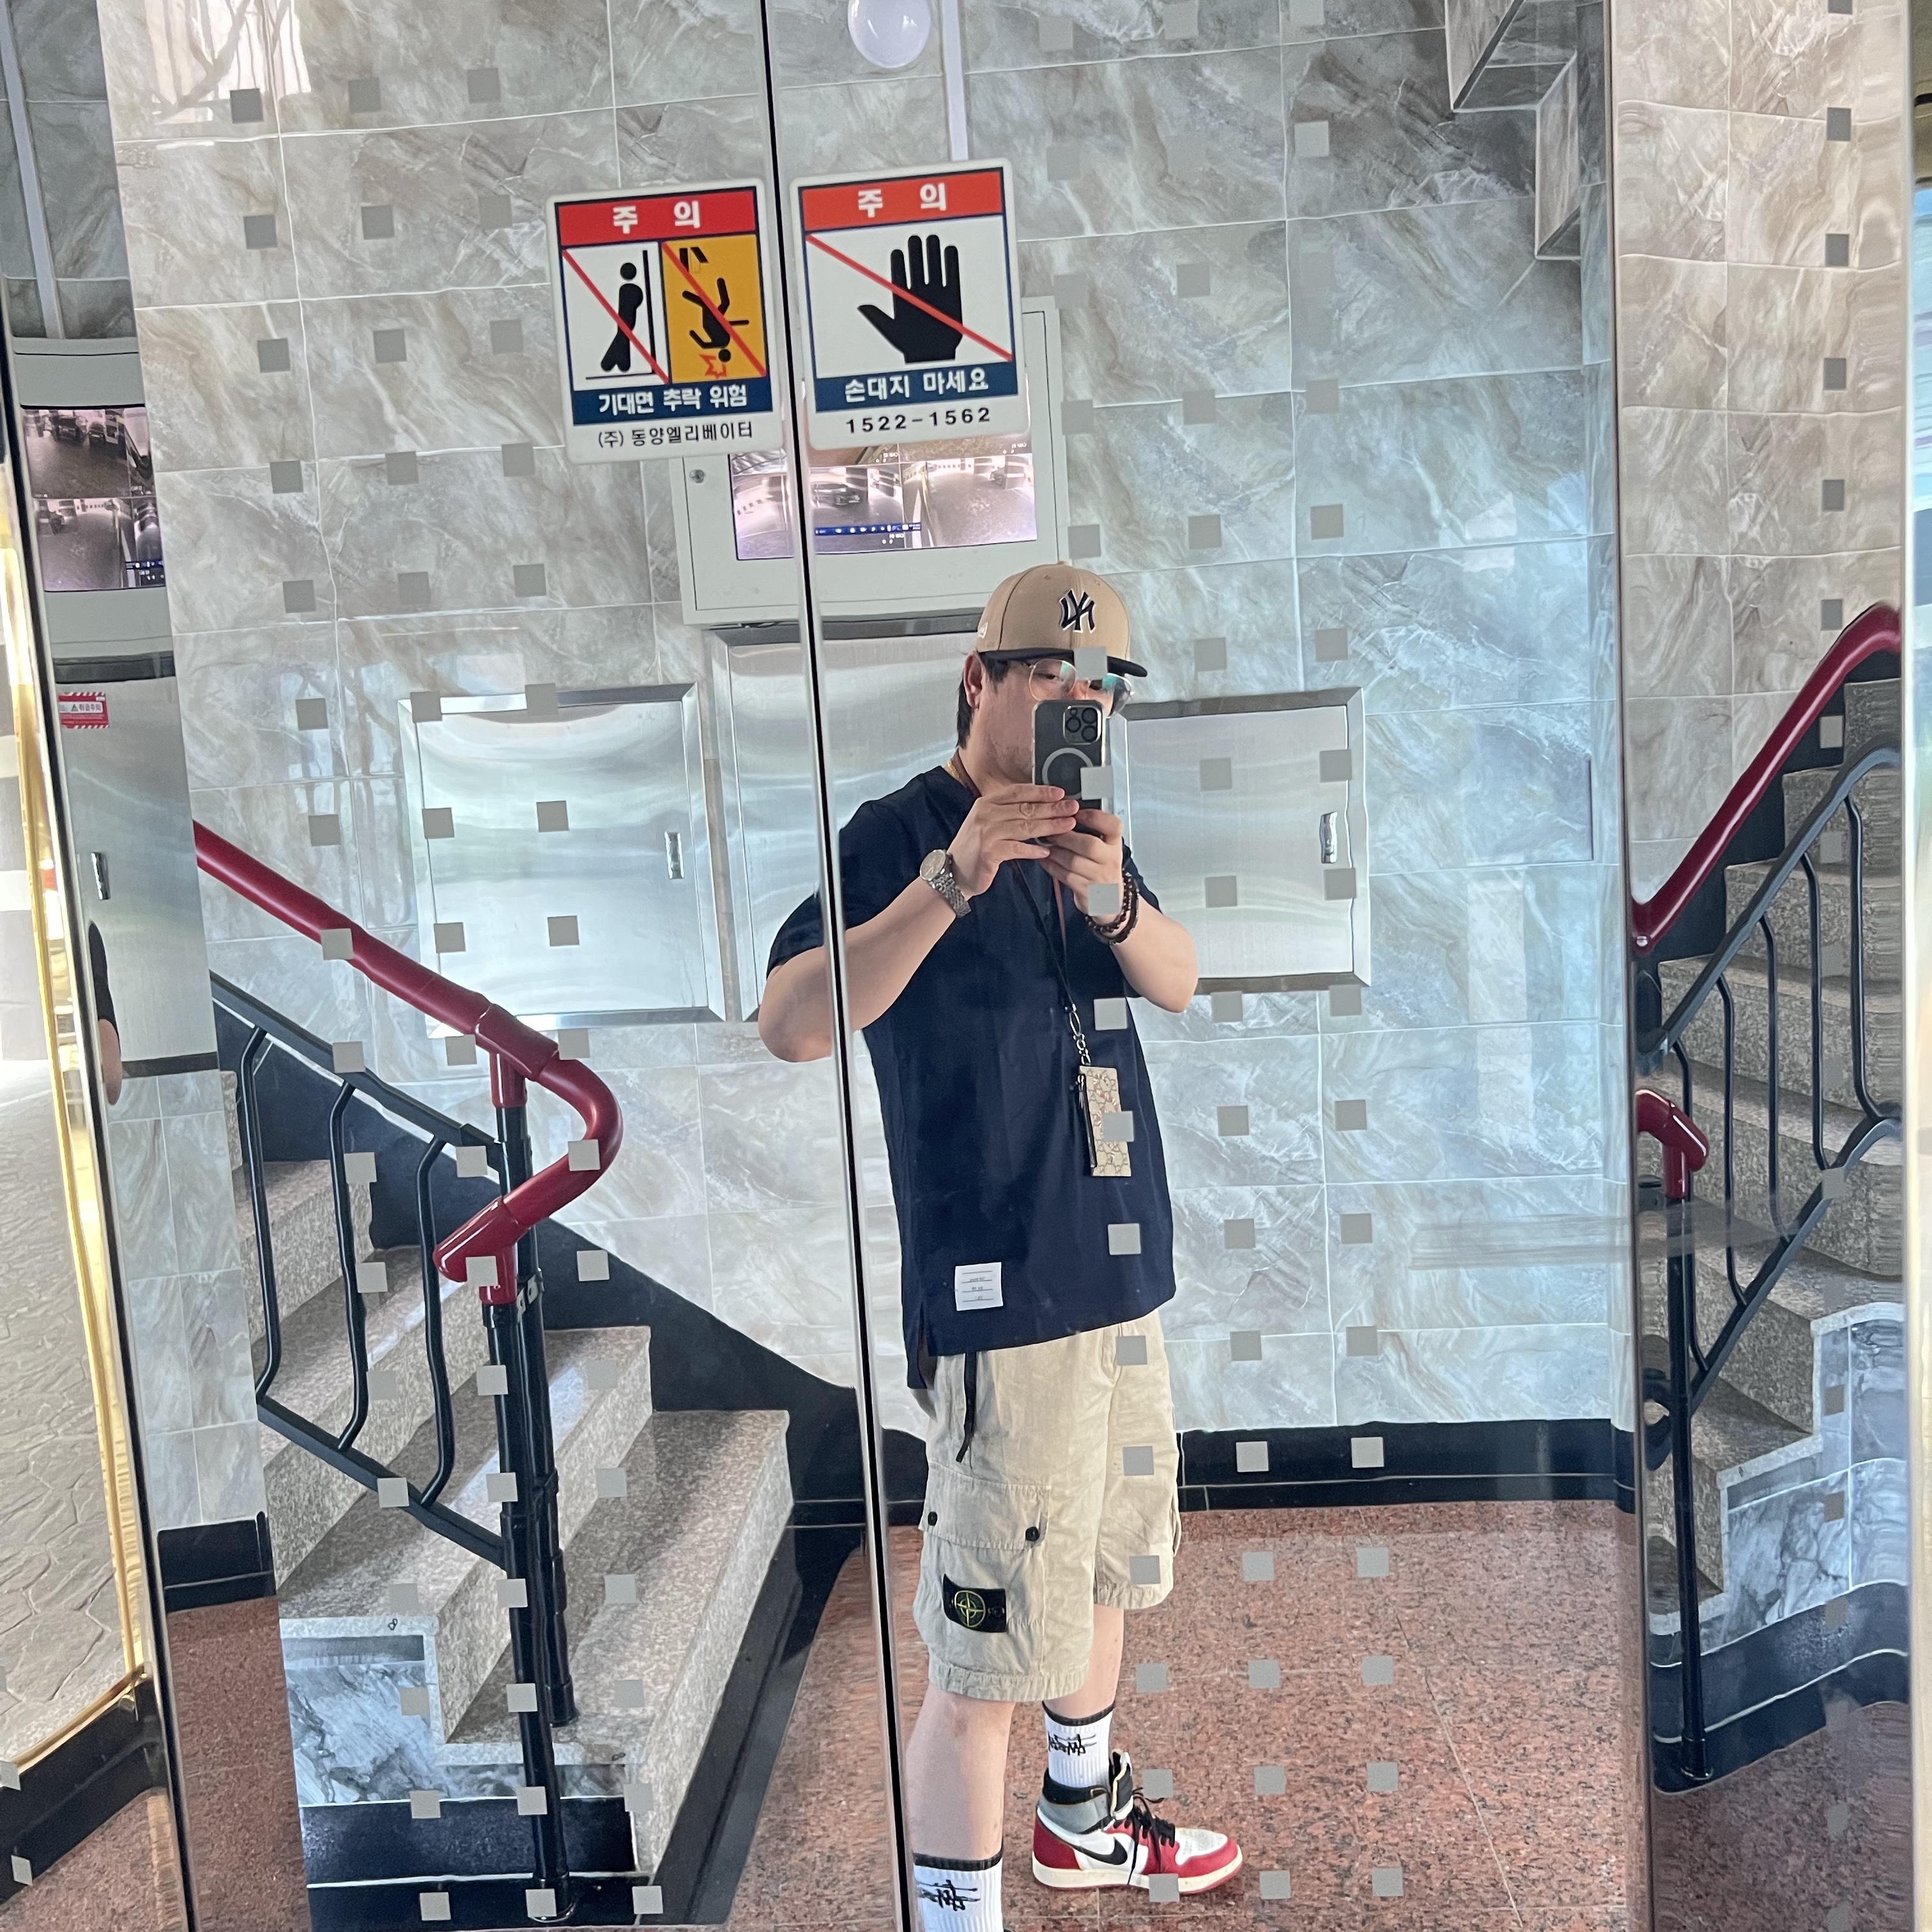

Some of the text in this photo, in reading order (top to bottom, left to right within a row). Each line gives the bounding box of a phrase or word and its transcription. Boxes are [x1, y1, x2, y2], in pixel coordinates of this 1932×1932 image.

[845, 367, 989, 403] 손대지 마세요
[599, 384, 747, 416] 기대면 추락 위험
[631, 421, 753, 447] 동양엘리베이터
[846, 407, 990, 434] 1522-1562
